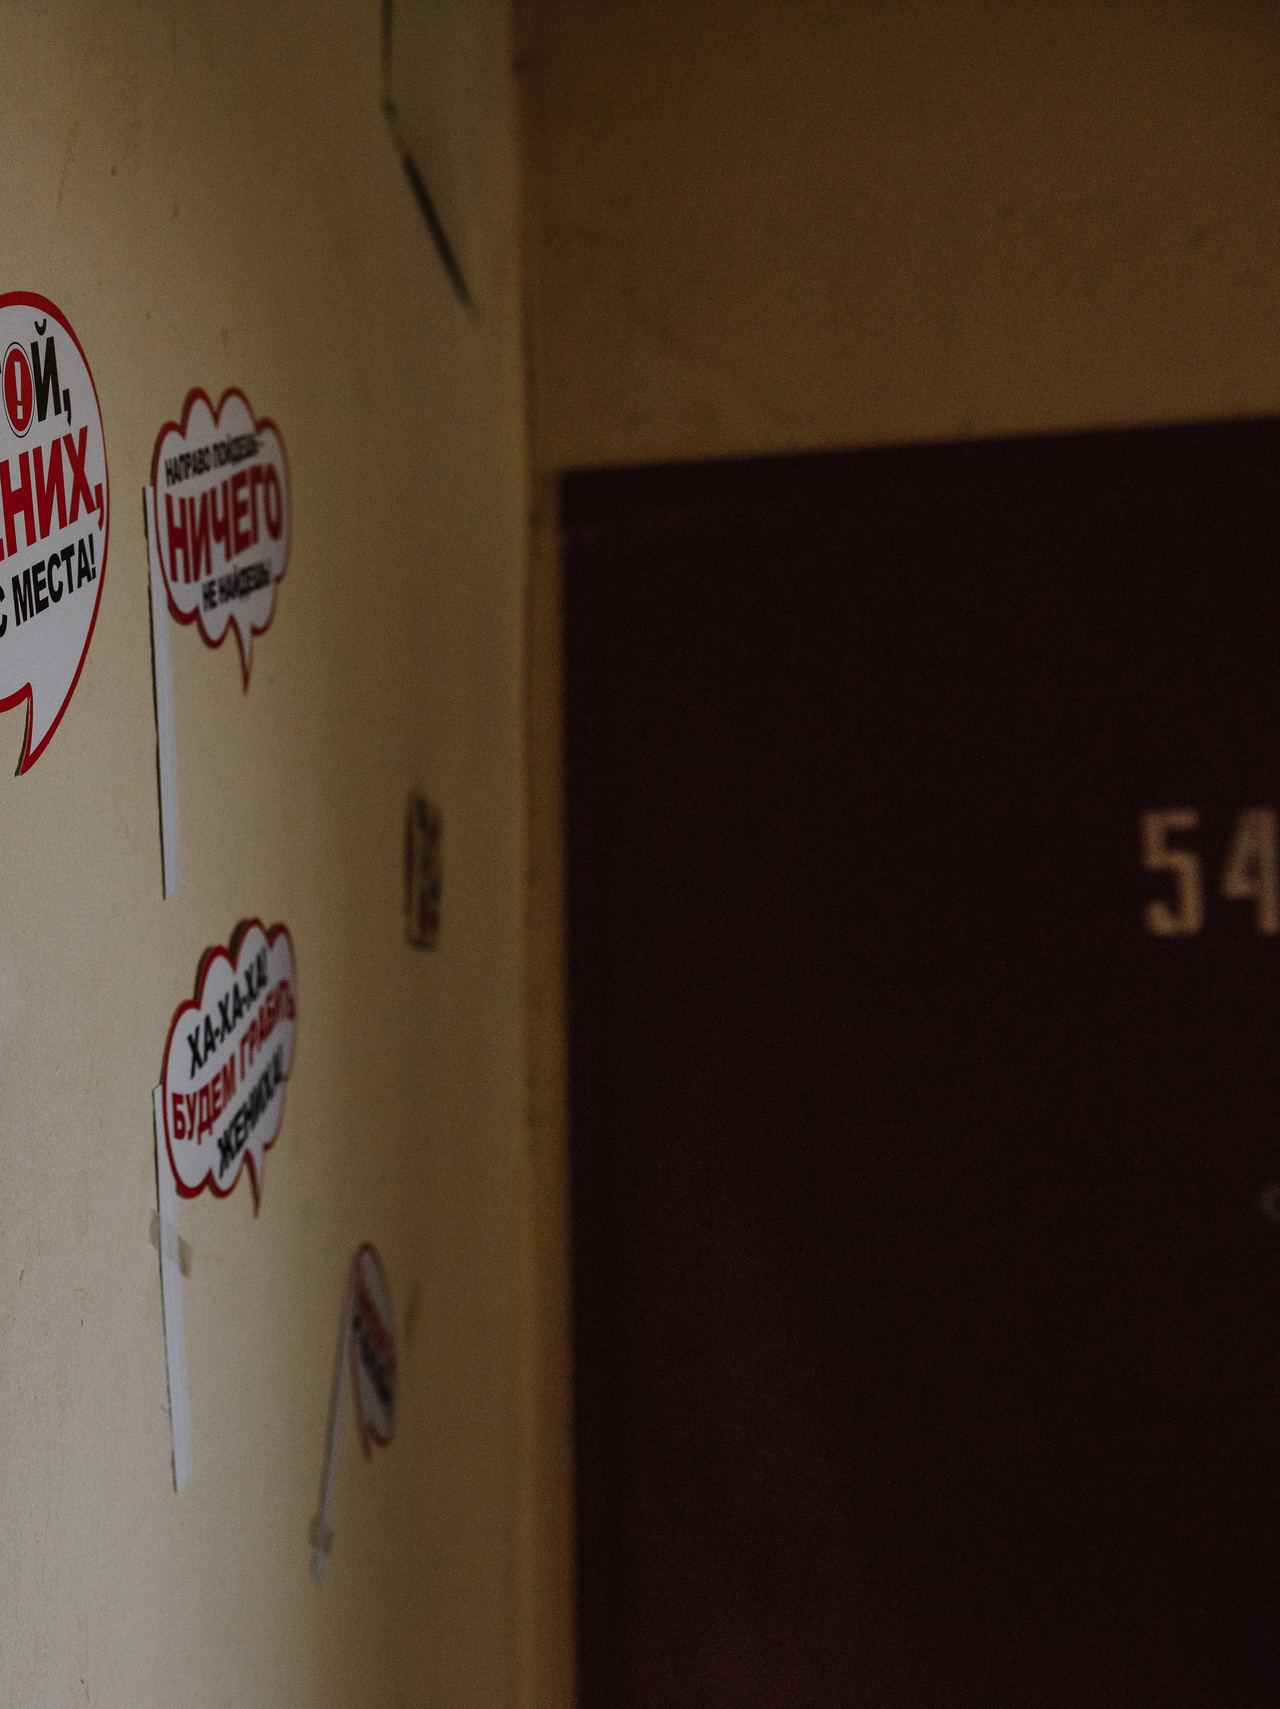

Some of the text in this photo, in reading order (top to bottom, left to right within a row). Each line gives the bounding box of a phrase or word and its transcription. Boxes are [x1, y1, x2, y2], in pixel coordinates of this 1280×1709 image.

[165, 463, 283, 584] НИЧЕГО
[12, 533, 96, 627] МЕСТА!
[172, 1052, 236, 1146] БУДЕМ
